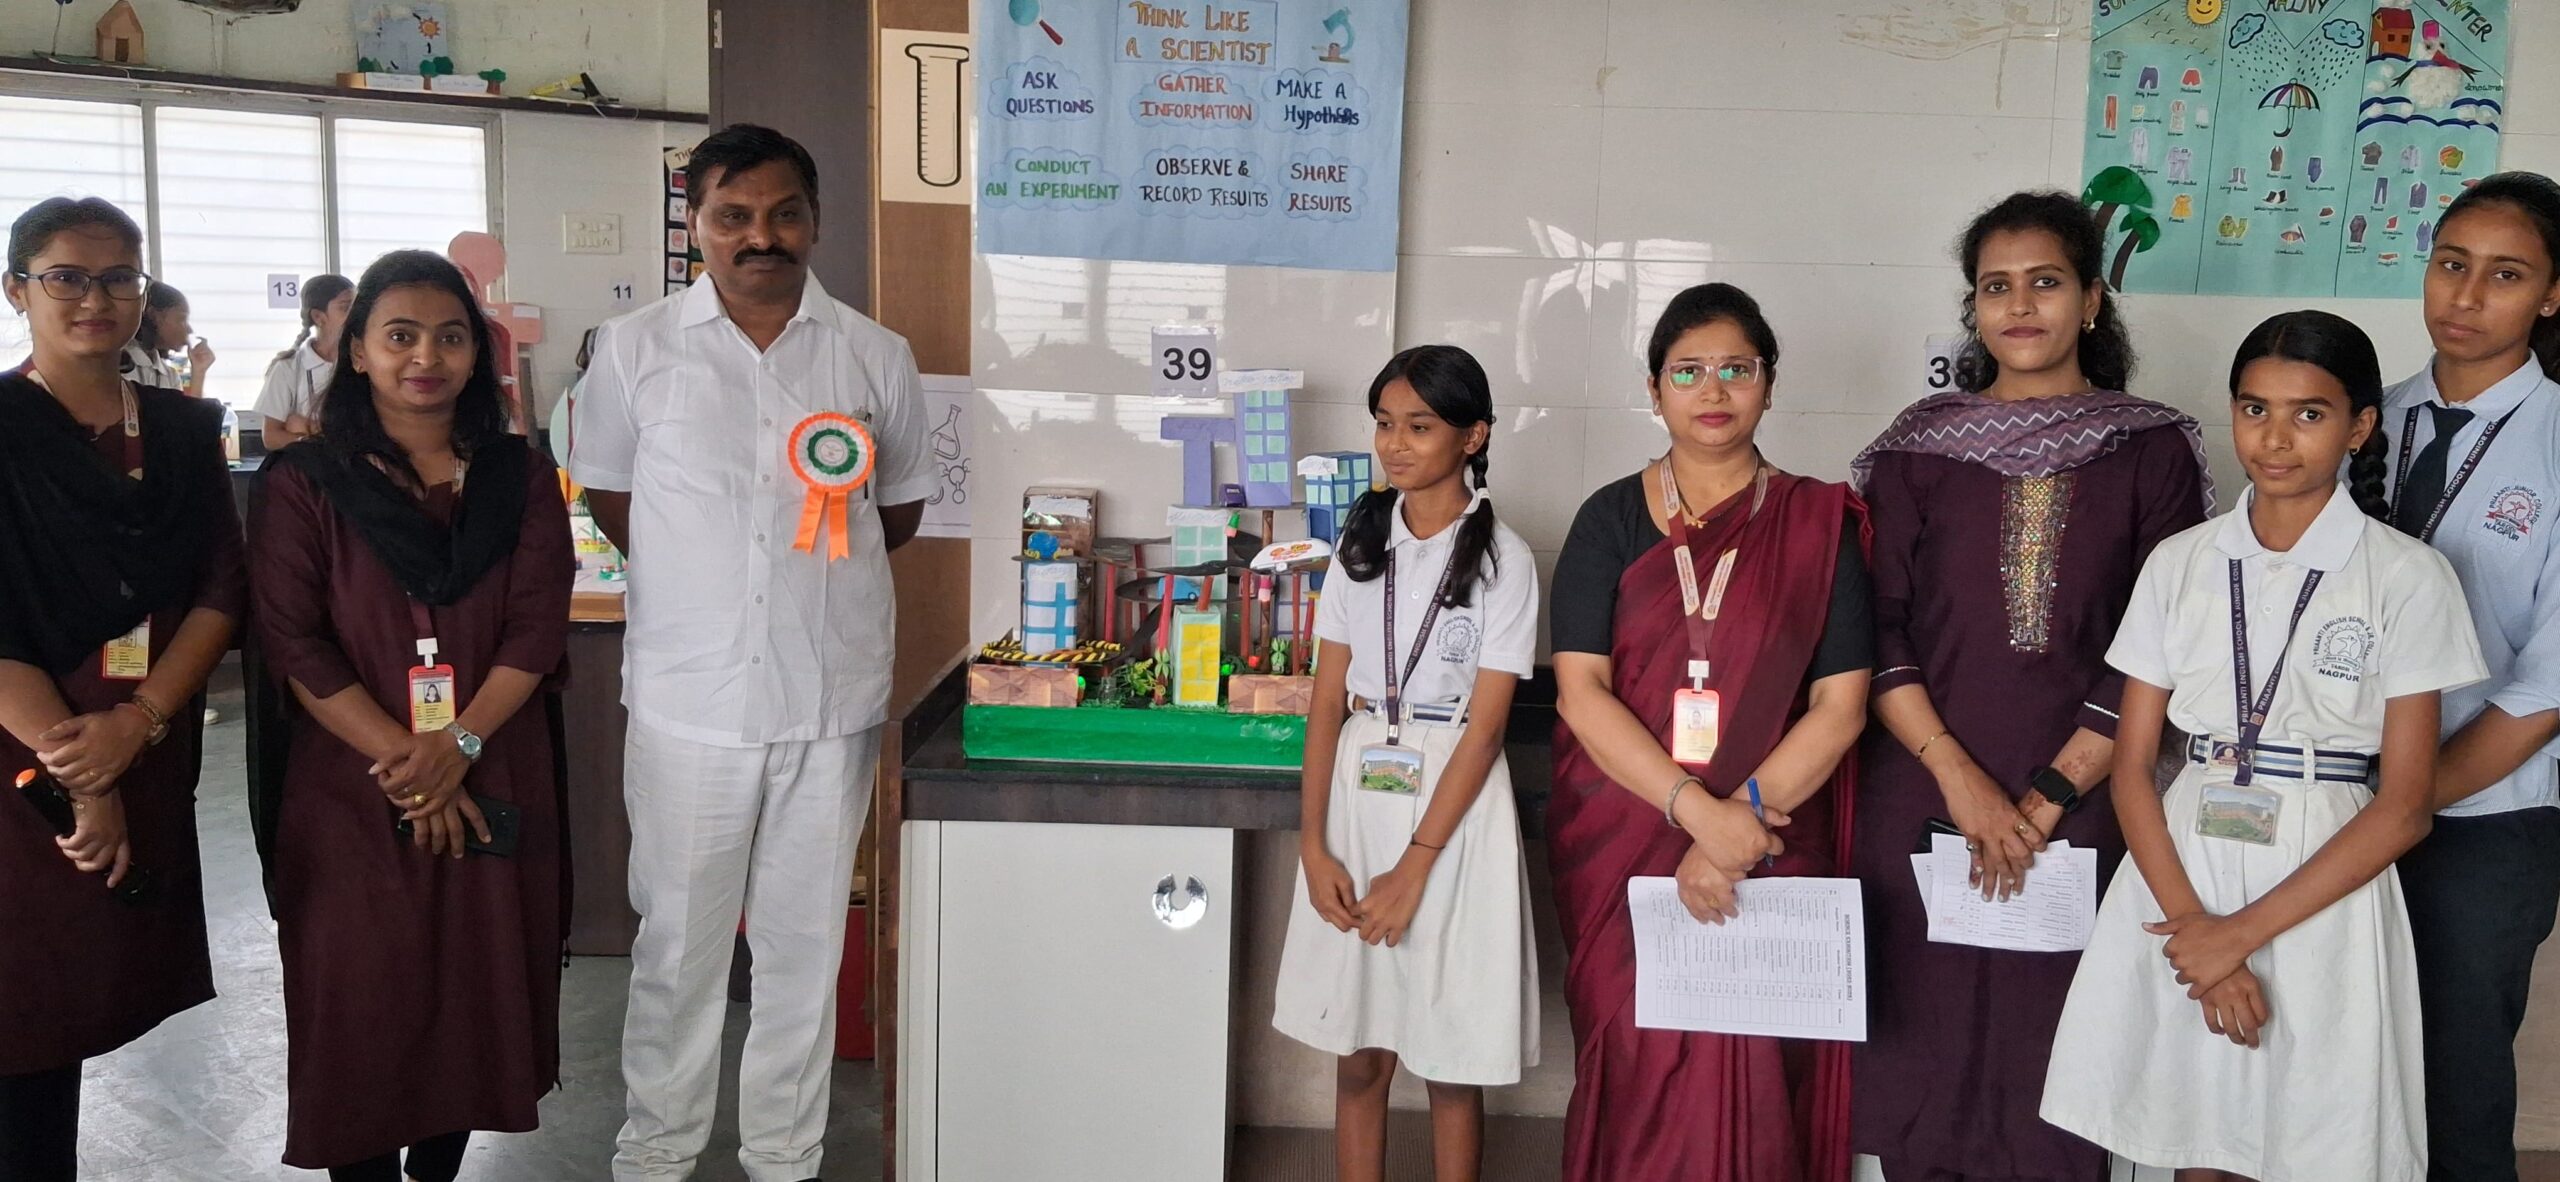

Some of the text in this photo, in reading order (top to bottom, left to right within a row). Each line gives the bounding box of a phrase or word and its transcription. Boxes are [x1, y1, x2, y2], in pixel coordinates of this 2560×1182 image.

[1129, 1, 1250, 32] THINK LIKE
[1125, 37, 1272, 65] A SCIENTIST
[1022, 71, 1059, 89] ASK
[1158, 74, 1228, 94] GATHER
[1275, 79, 1347, 99] MAKE A
[1006, 97, 1095, 118] QUESTIONS
[1139, 101, 1253, 121] INFORMATION
[1015, 158, 1092, 175] CONDUCT
[1156, 158, 1251, 177] OBSERVE &
[1290, 162, 1349, 183] SHARE
[985, 181, 1120, 200] AN EXPERIMENT
[1139, 185, 1203, 204] RECORD
[273, 281, 297, 297] 13
[613, 284, 632, 299] 11
[1162, 347, 1212, 381] 39
[2426, 498, 2446, 528] ENGLISH
[2446, 470, 2466, 498] SCHOOL
[2468, 435, 2488, 463] JUNIOR
[2483, 522, 2520, 542] NAGPUR
[2301, 573, 2319, 601] JUNIOR
[1413, 628, 1425, 656] ENGLISH
[1424, 602, 1439, 628] SCHOOL
[2236, 621, 2244, 651] SCHOOL
[2318, 667, 2360, 682] NAGPUR
[2258, 675, 2277, 711] PRIAANTI
